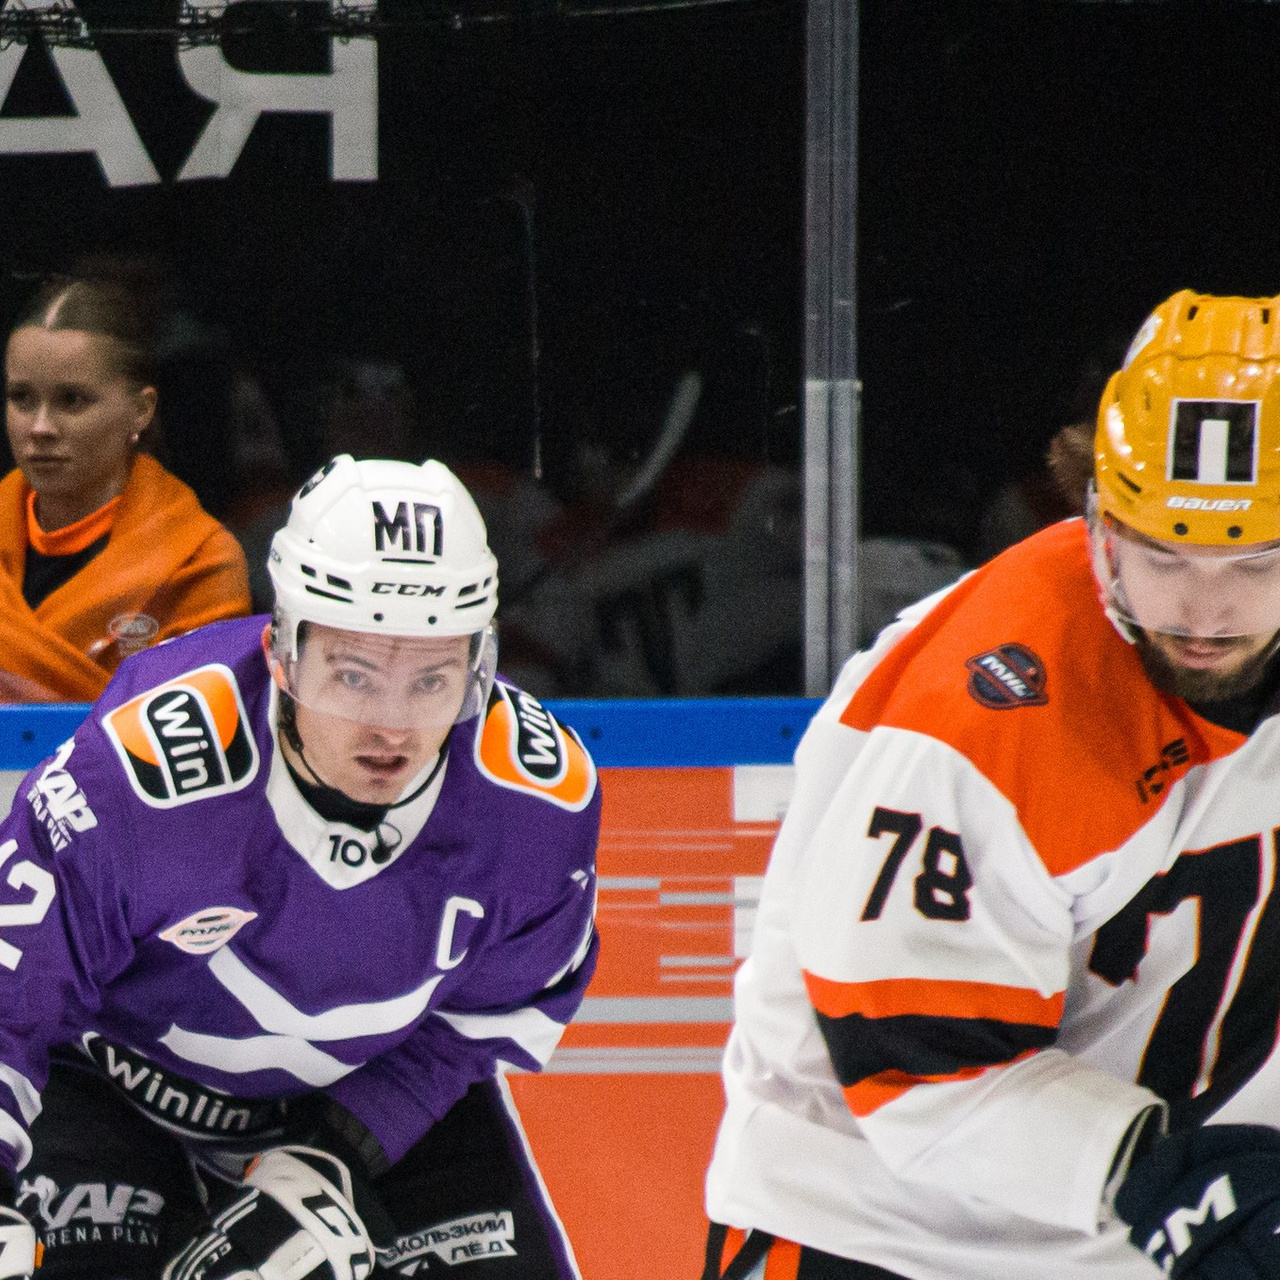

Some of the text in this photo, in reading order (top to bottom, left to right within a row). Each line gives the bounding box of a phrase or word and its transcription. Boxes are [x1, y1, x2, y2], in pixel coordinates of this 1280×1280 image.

[1165, 496, 1253, 512] BAUER
[371, 582, 447, 598] CCM
[329, 834, 368, 868] 10
[859, 805, 974, 922] 78
[435, 895, 485, 971] C
